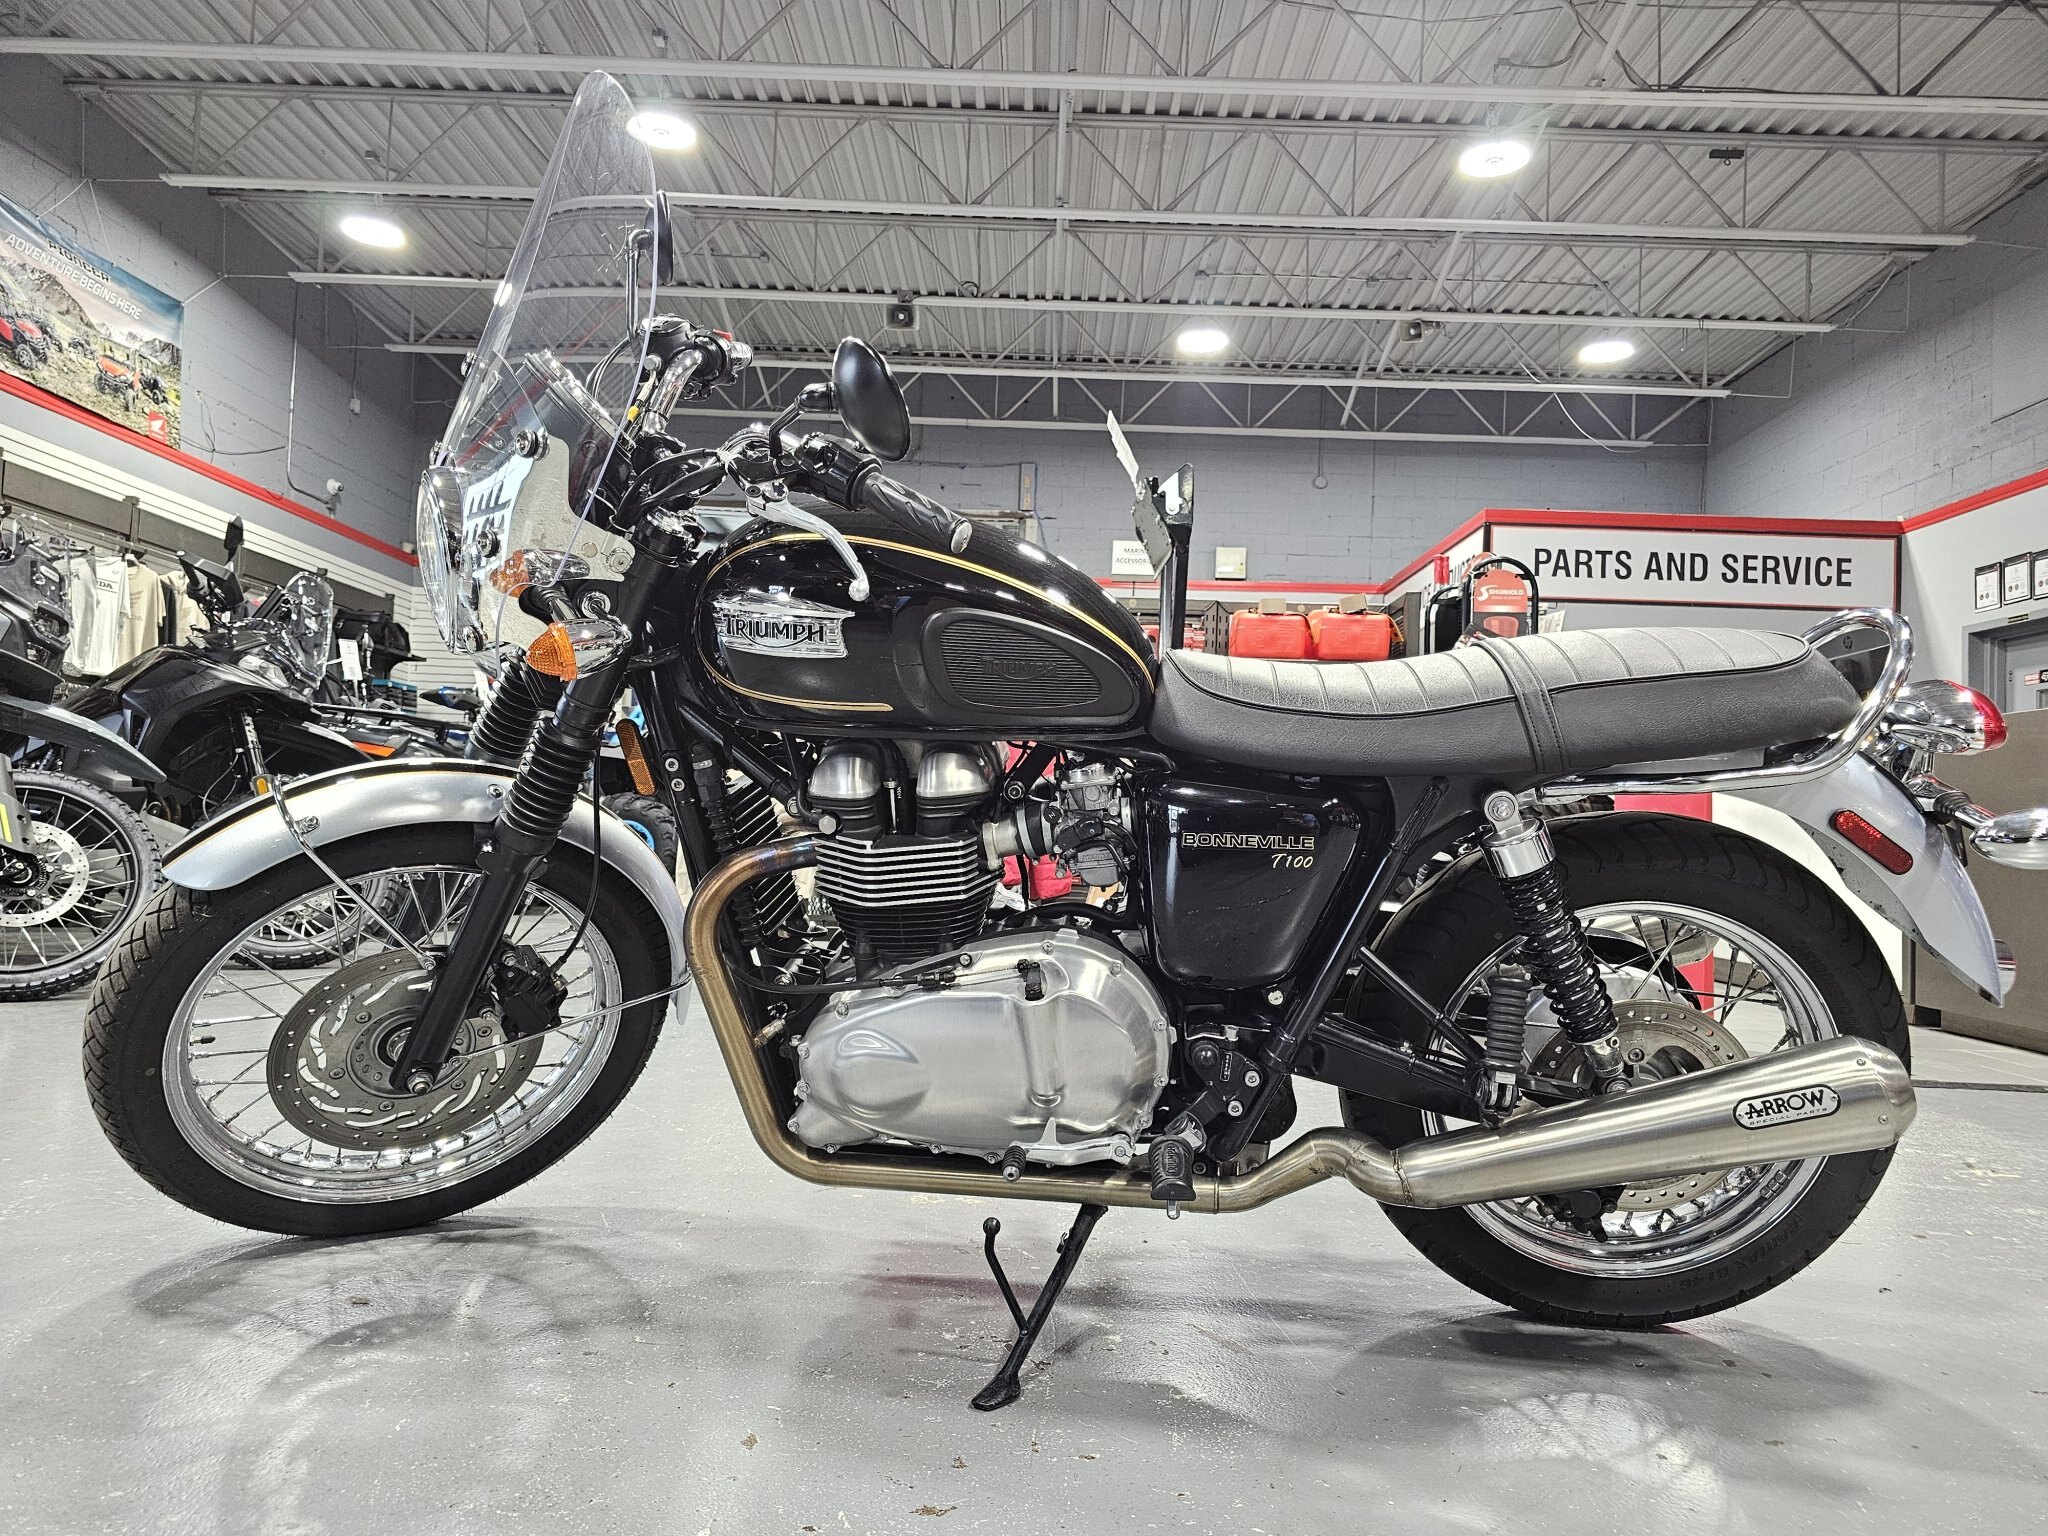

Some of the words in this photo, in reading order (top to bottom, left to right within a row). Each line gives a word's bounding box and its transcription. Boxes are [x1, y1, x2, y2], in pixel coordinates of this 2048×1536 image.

[5, 234, 80, 281] ADVENTURE
[80, 275, 117, 305] BEGINS
[115, 297, 142, 319] HERE
[48, 240, 111, 284] PIONEER
[1534, 548, 1633, 580] PARTS
[1644, 552, 1709, 582] AND
[1721, 553, 1852, 587] SERVICE
[726, 617, 824, 648] TRIUMPH
[980, 655, 1058, 680] TRIUMPH
[1182, 832, 1315, 850] BONNEVILLE
[1271, 853, 1314, 869] T100
[1745, 1089, 1824, 1119] ARROW
[1749, 1114, 1791, 1125] SPECIAL
[1796, 1107, 1828, 1117] PARTS
